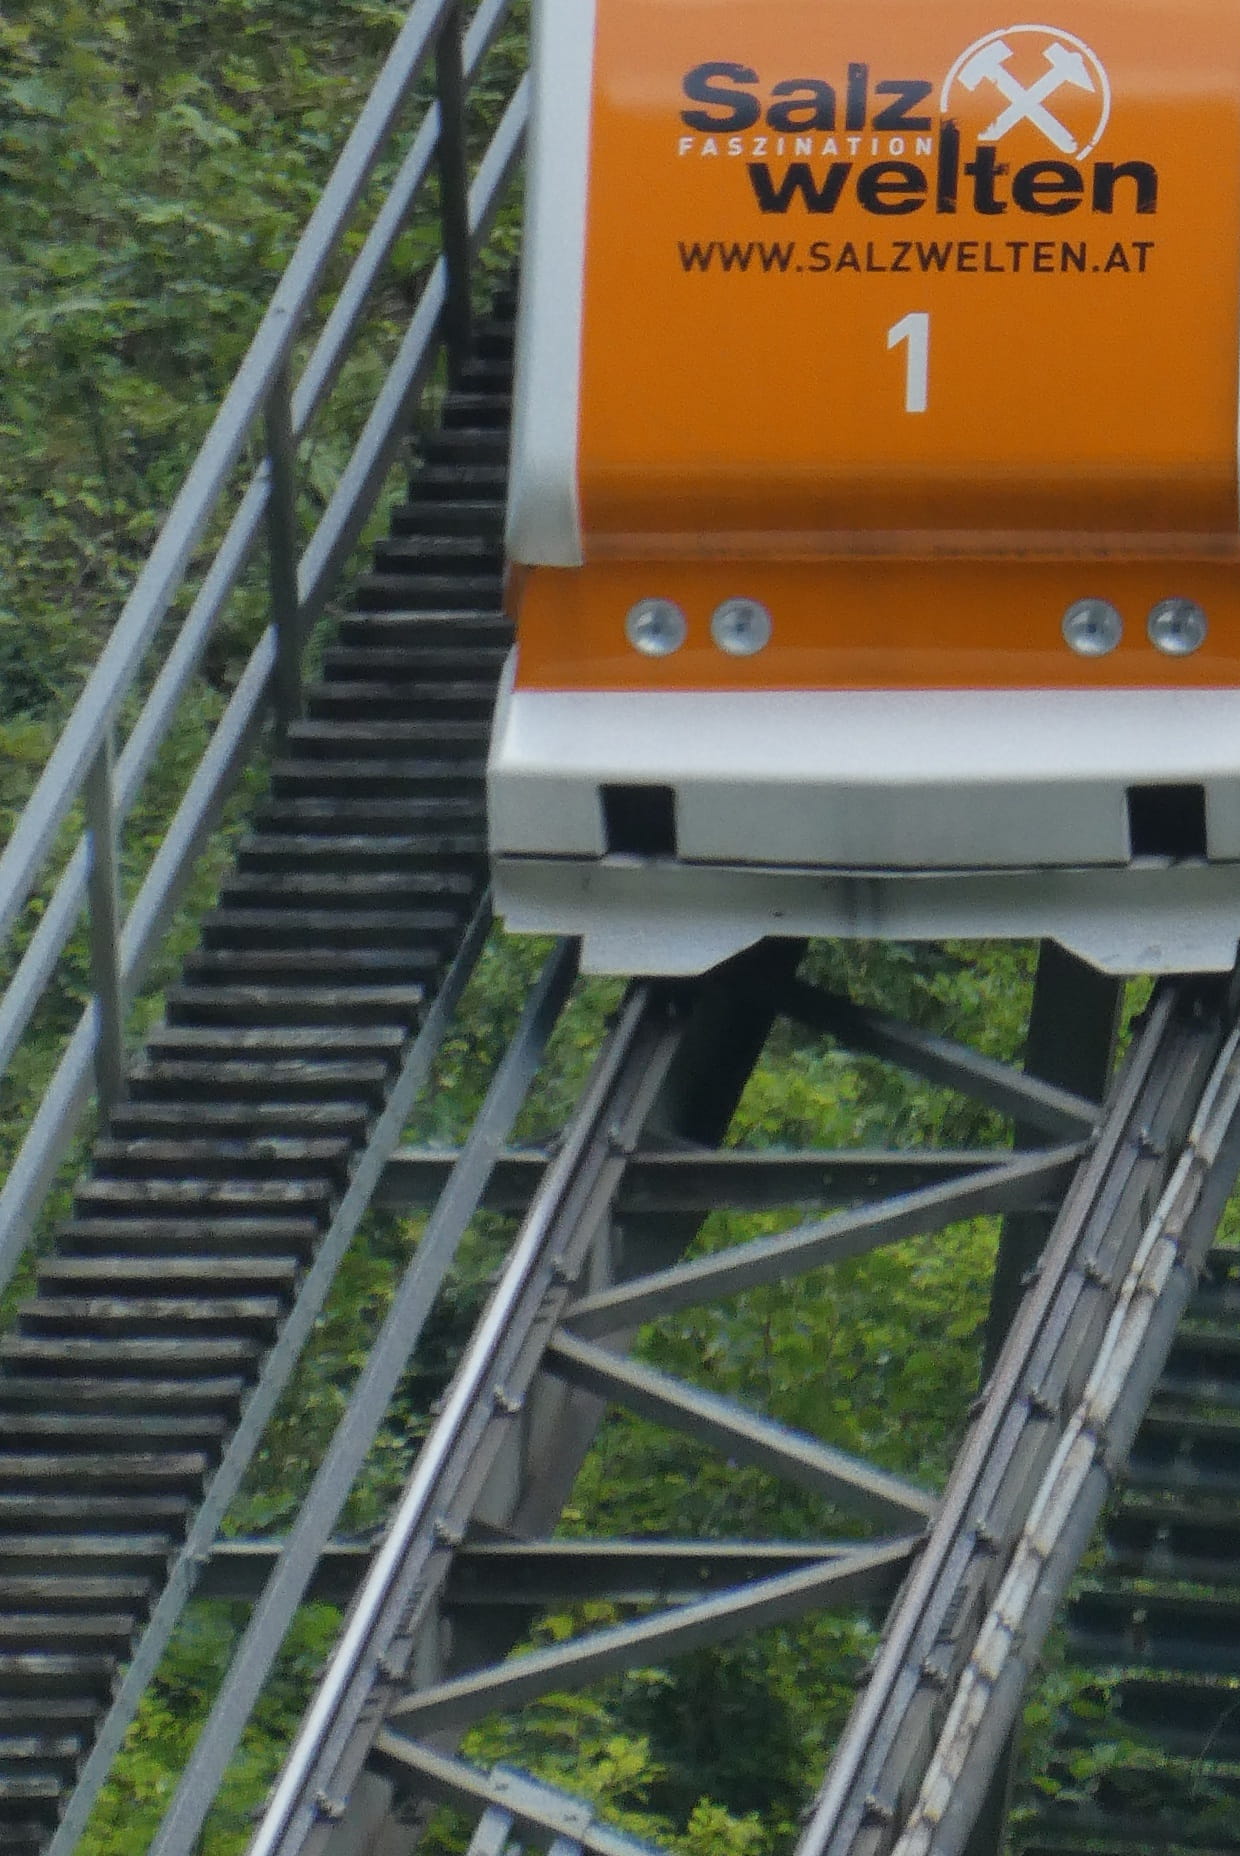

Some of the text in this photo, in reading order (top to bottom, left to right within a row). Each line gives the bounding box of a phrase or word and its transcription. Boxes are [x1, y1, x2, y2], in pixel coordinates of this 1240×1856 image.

[682, 62, 932, 133] Salz
[678, 137, 932, 156] FASZINATION
[747, 120, 1158, 215] welten
[677, 242, 1155, 273] WWW.SALZWELTEN.AT
[887, 313, 930, 412] 1
